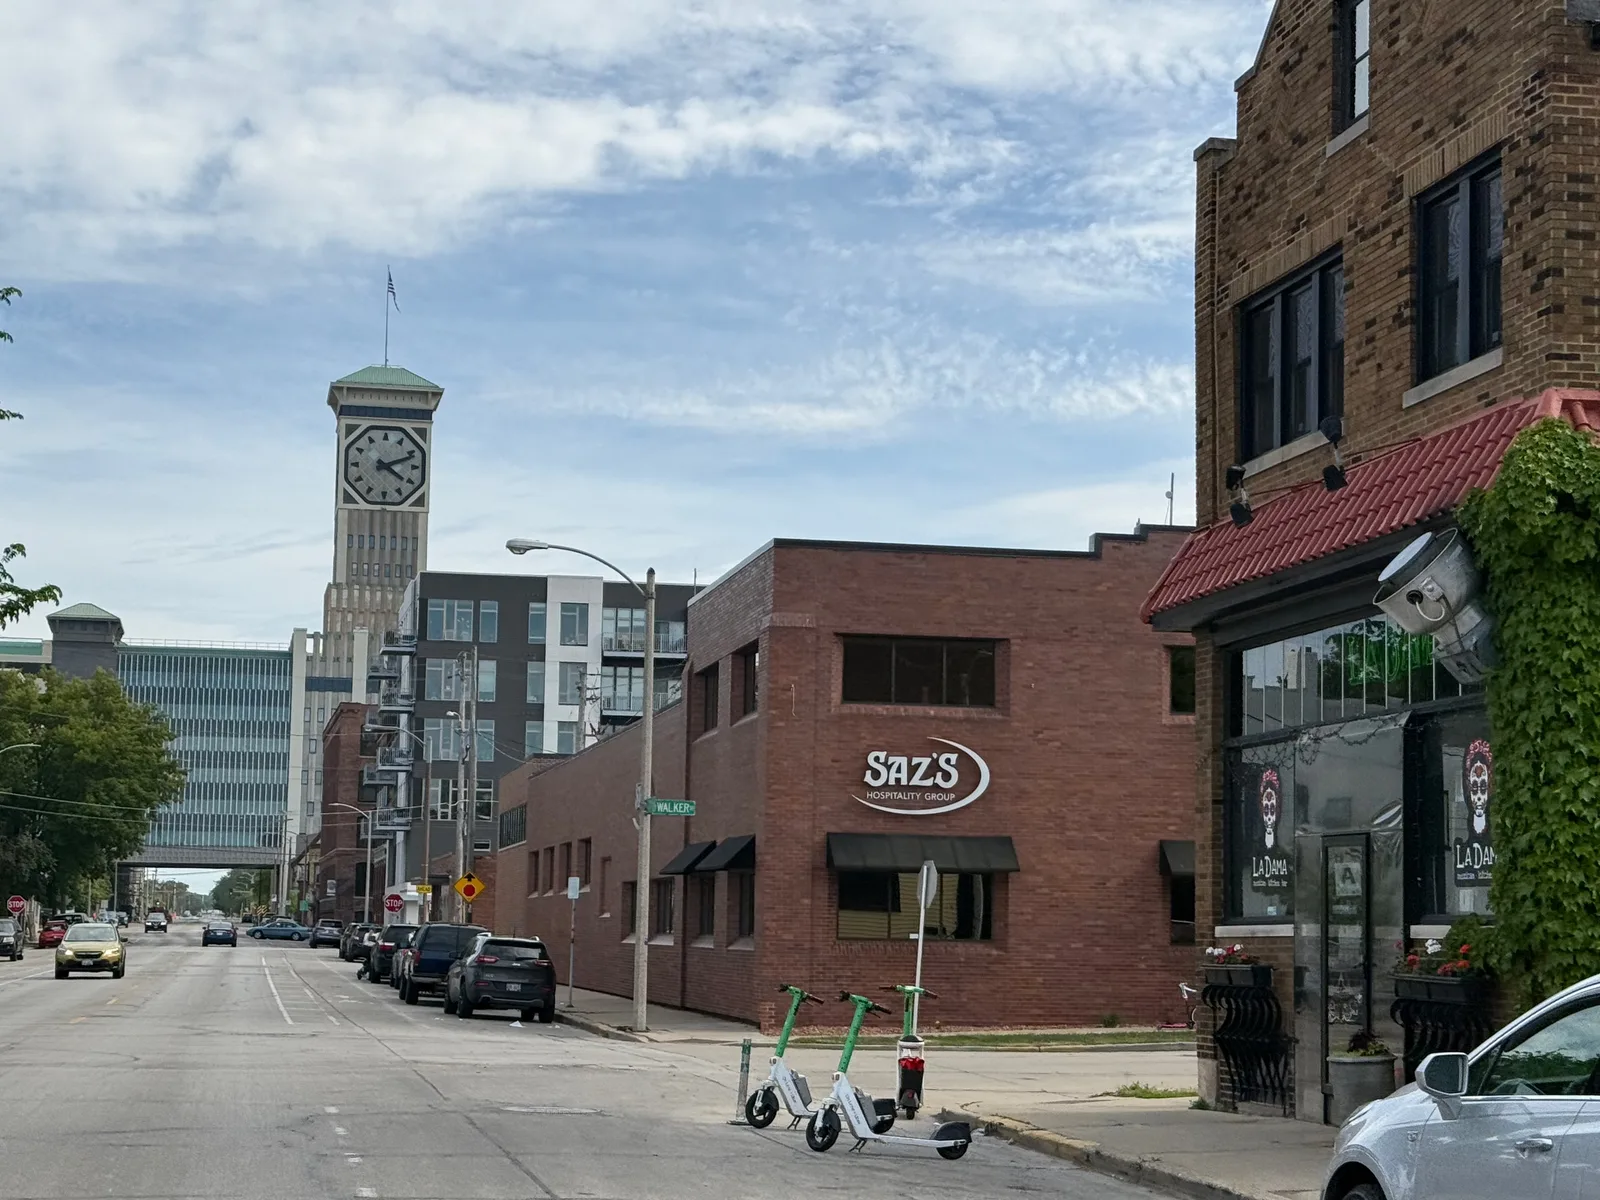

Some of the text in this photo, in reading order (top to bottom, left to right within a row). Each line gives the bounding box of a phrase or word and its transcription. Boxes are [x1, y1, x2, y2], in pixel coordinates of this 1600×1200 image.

[863, 751, 959, 789] SAZ'S
[866, 791, 955, 802] HOSPITALITY GROUP
[656, 802, 690, 813] WALKER
[1456, 842, 1498, 868] LA DAM
[1252, 855, 1288, 877] LA DAMA
[8, 900, 24, 908] STOP
[385, 899, 403, 907] STOP
